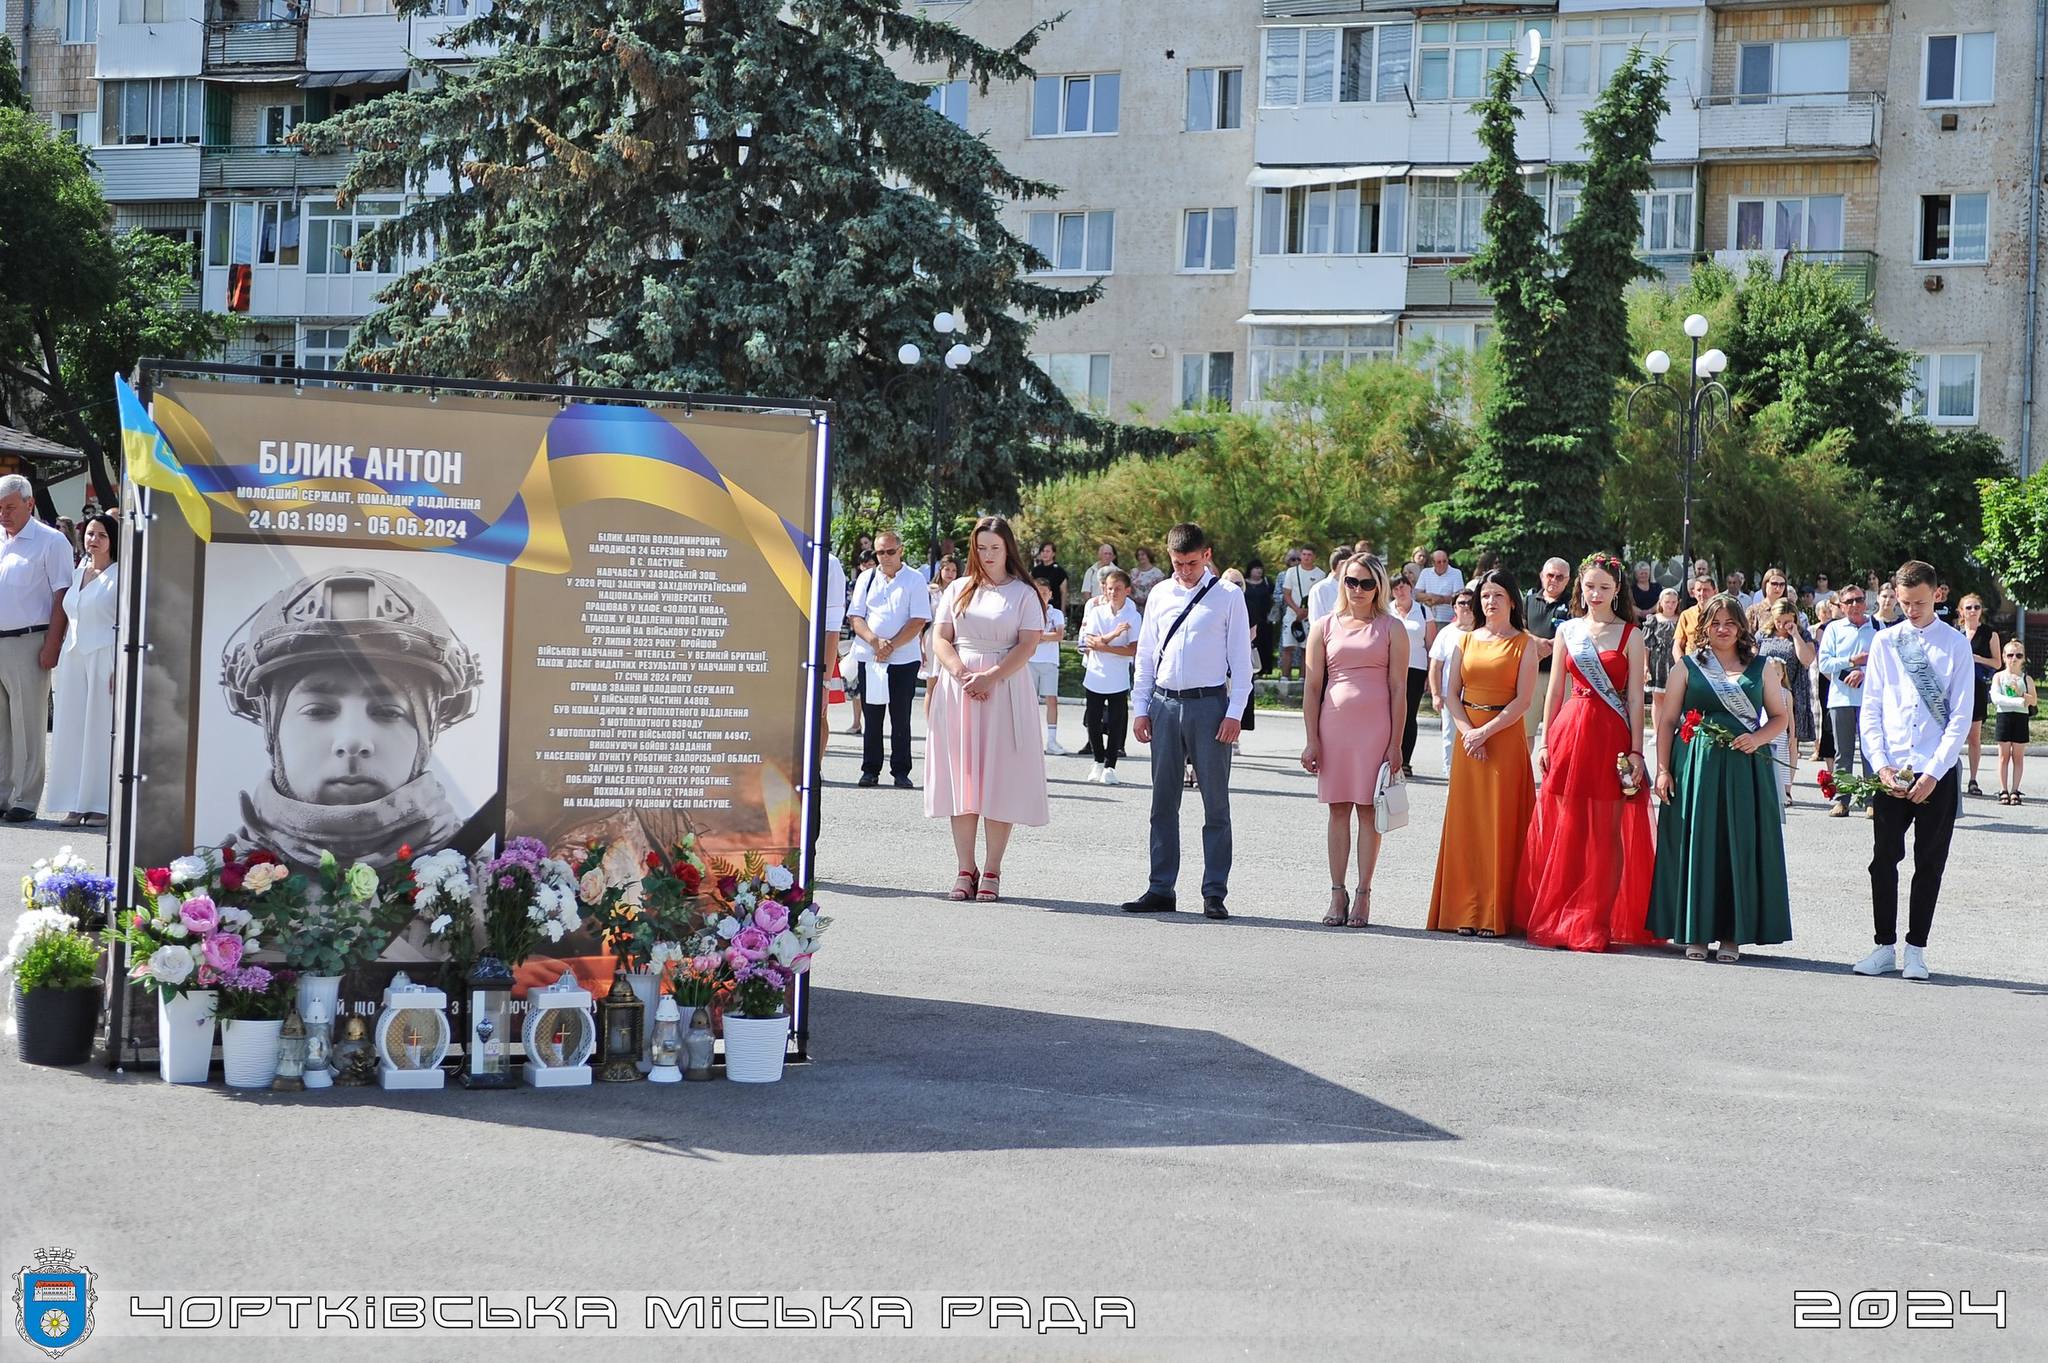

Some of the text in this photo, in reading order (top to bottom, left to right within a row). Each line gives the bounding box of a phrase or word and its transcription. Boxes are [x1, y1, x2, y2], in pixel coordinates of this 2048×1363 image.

[258, 440, 462, 484] БІЛИК АНТОН
[237, 486, 481, 510] МОЛОДШИЙ СЕРЖАНТ, КОМАНДИР ВІДДІЛЕННЯ
[249, 510, 348, 533] 24.03.1999
[368, 516, 467, 539] 05.05.2024
[598, 533, 720, 546] БІЛИК АНТОН ВОЛОДИМИРОВИЧ
[589, 544, 728, 558] НАРОДИВСЯ 24 БЕРЕЗНЯ 1999 РОКУ
[630, 557, 635, 566] В
[648, 558, 687, 568] ПАСТУШЕ.
[597, 568, 638, 577] НАВЧАВСЯ
[640, 569, 646, 578] У
[648, 569, 697, 580] ЗАВОДСЬКІЙ
[567, 578, 747, 592] У 2020 РОЦІ ЗАКІНЧИВ ЗАХІДНОУКРАЇНСЬКИЙ
[598, 590, 658, 602] НАЦІОНАЛЬНИЙ
[585, 602, 628, 612] ПРАЦЮВАВ
[630, 604, 636, 612] У
[638, 604, 660, 612] КАФЕ
[581, 613, 586, 622] А
[589, 614, 616, 622] ТАКОЖ
[619, 614, 625, 623] У
[626, 614, 672, 625] ВІДДІЛЕННІ
[674, 616, 698, 625] НОВОЇ
[585, 624, 724, 638] ПРИЗВАНИЙ НА ВІЙСЬКОВУ СЛУЖБУ
[592, 636, 602, 646] 27
[604, 637, 632, 646] ЛИПНЯ
[634, 638, 652, 646] 2023
[681, 638, 717, 648] ПРОЙШОВ
[538, 645, 580, 656] ВІЙСЬКОВІ
[582, 648, 624, 658] НАВЧАННЯ
[634, 650, 676, 658] INTERFLEX
[688, 651, 693, 660] У
[695, 650, 728, 660] ВЕЛИКІЙ
[536, 658, 564, 667] ТАКОЖ
[566, 658, 592, 668] ДОСЯГ
[594, 660, 636, 670] ВИДАТНИХ
[638, 661, 688, 670] РЕЗУЛЬТАТІВ
[690, 662, 696, 671] У
[698, 662, 736, 672] НАВЧАННІ
[738, 663, 744, 672] В
[614, 672, 692, 682] 17 СІЧНЯ 2024 РОКУ
[570, 682, 734, 694] ОТРИМАВ ЗВАННЯ МОЛОДШОГО СЕРЖАНТА
[593, 694, 599, 703] У
[601, 694, 647, 704] ВІЙСЬКОВІЙ
[650, 696, 682, 705] ЧАСТИНІ
[554, 705, 748, 718] БУВ КОМАНДИРОМ 2 МОТОПІХОТНОГО ВІДДІЛЕННЯ
[607, 718, 670, 728] МОТОПІХОТНОГО
[672, 720, 703, 728] ВЗВОДУ
[556, 728, 614, 738] МОТОПІХОТНОЇ
[617, 730, 637, 738] РОТИ
[639, 729, 685, 740] ВІЙСЬКОВОЇ
[688, 731, 722, 740] ЧАСТИНИ
[589, 740, 712, 752] ВИКОНУЮЧИ БОЙОВІ ЗАВДАННЯ
[536, 751, 542, 760] У
[544, 751, 597, 761] НАСЕЛЕНОМУ
[599, 752, 631, 762] ПУНКТУ
[633, 753, 672, 762] РОБОТИНЕ
[674, 753, 726, 763] ЗАПОРІЗЬКОЇ
[588, 764, 711, 774] ЗАГИНУВ 5 ТРАВНЯ 2024 РОКУ
[566, 774, 602, 784] ПОБЛИЗУ
[604, 776, 654, 784] НАСЕЛЕНОГО
[656, 776, 688, 785] ПУНКТУ
[594, 786, 704, 796] ПОХОВАЛИ ВОЇНА 12 ТРАВНЯ
[564, 798, 574, 806] НА
[576, 798, 625, 808] КЛАДОВИЩІ
[627, 800, 633, 808] У
[635, 799, 671, 808] РІДНОМУ
[673, 800, 691, 808] СЕЛІ
[354, 1001, 375, 1016] ЩО
